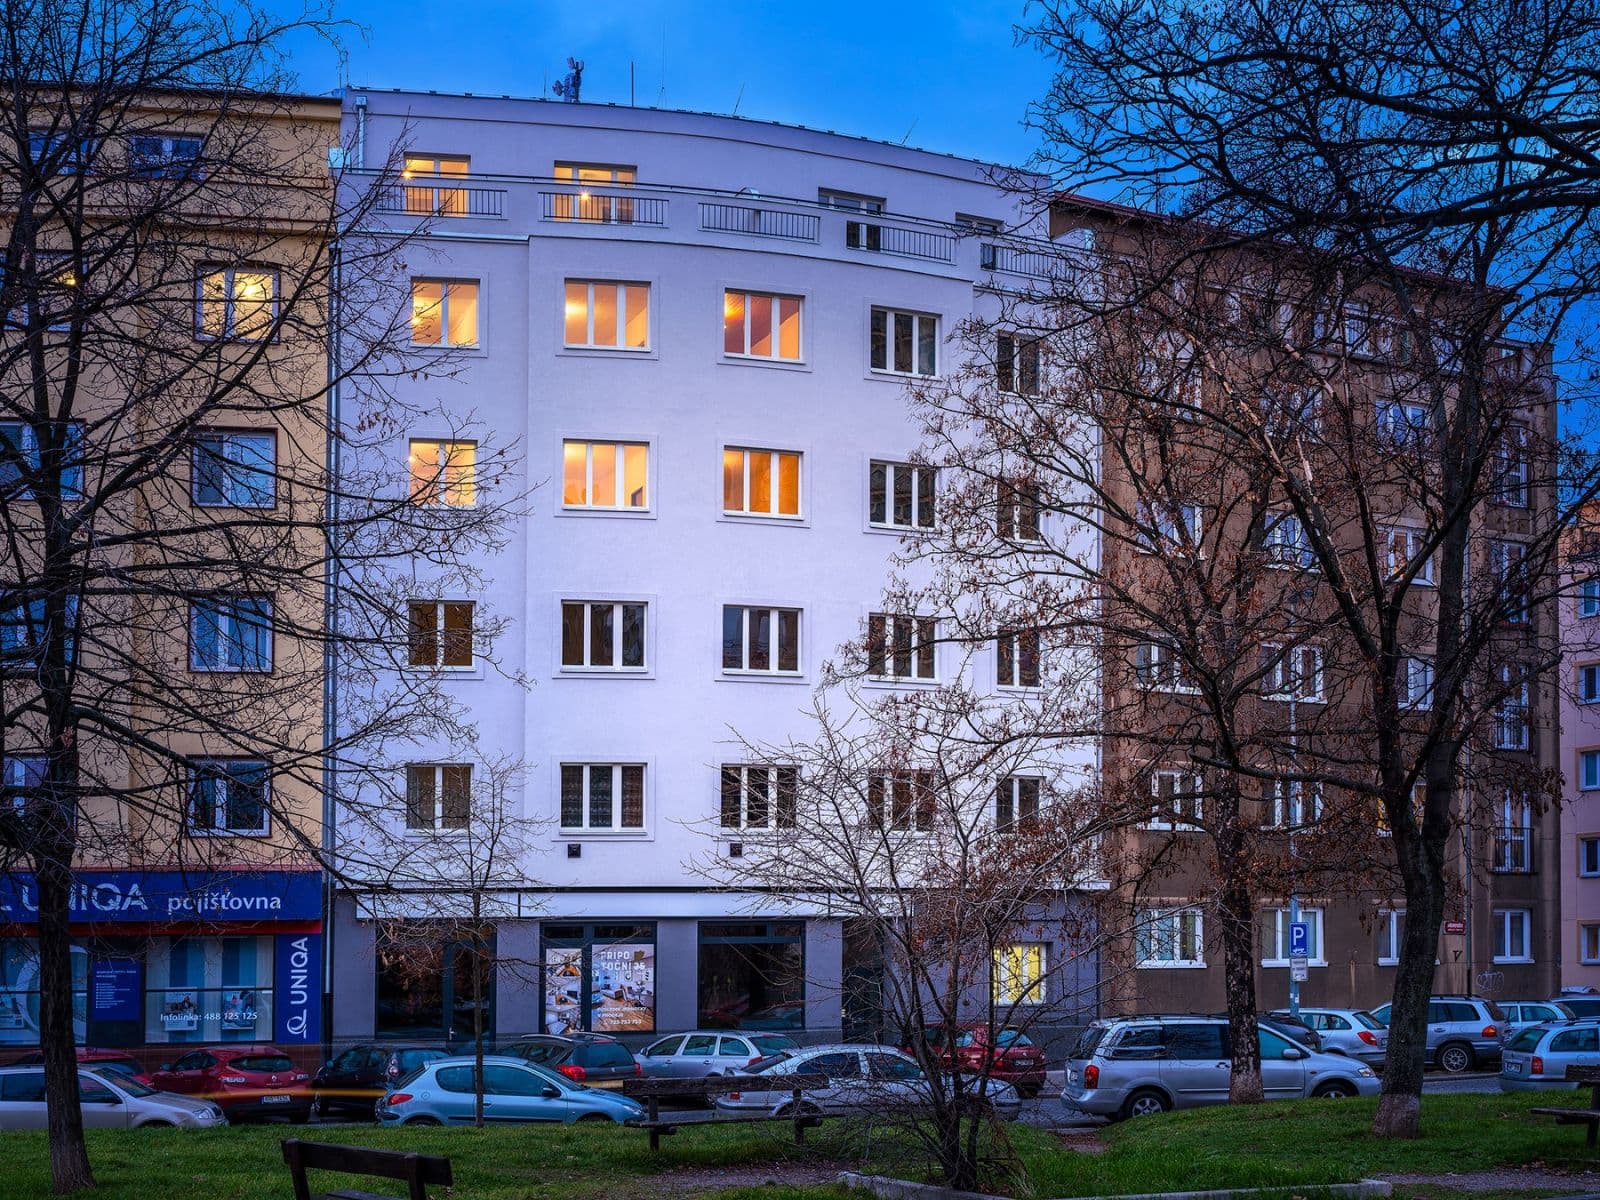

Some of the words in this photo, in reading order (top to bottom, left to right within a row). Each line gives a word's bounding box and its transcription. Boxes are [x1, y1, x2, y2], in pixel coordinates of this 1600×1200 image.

[22, 883, 148, 911] UIQA
[168, 891, 281, 915] pojišťovna
[1293, 926, 1305, 946] P
[290, 937, 308, 1005] UNIQA
[160, 1013, 202, 1021] Infolinka:
[204, 1012, 221, 1021] 488
[224, 1011, 239, 1020] 125
[242, 1011, 258, 1020] 125
